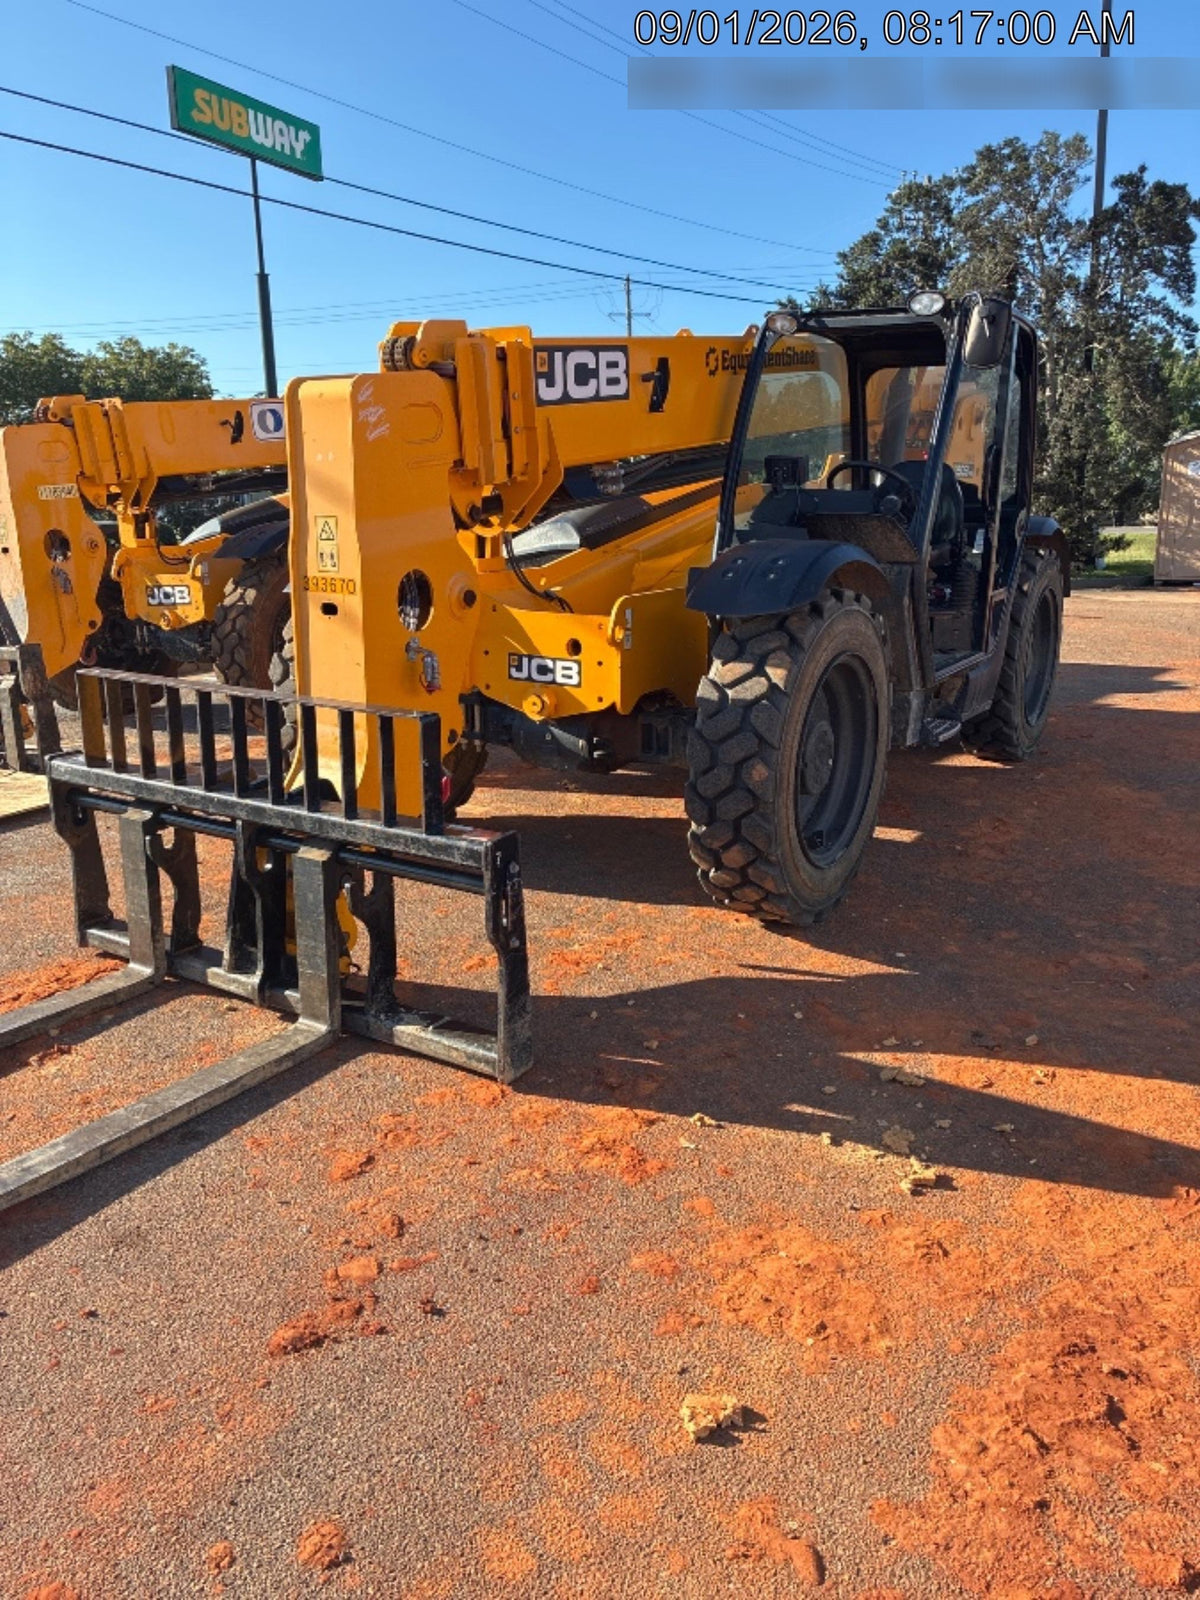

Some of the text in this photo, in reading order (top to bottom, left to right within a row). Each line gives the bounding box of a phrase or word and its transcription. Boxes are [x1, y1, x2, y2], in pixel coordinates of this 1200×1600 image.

[191, 87, 311, 159] SUBWAY
[537, 349, 629, 401] JCB
[722, 346, 816, 375] EquientShare
[148, 585, 191, 606] JCB
[303, 575, 357, 595] 393670
[509, 655, 581, 686] JCB
